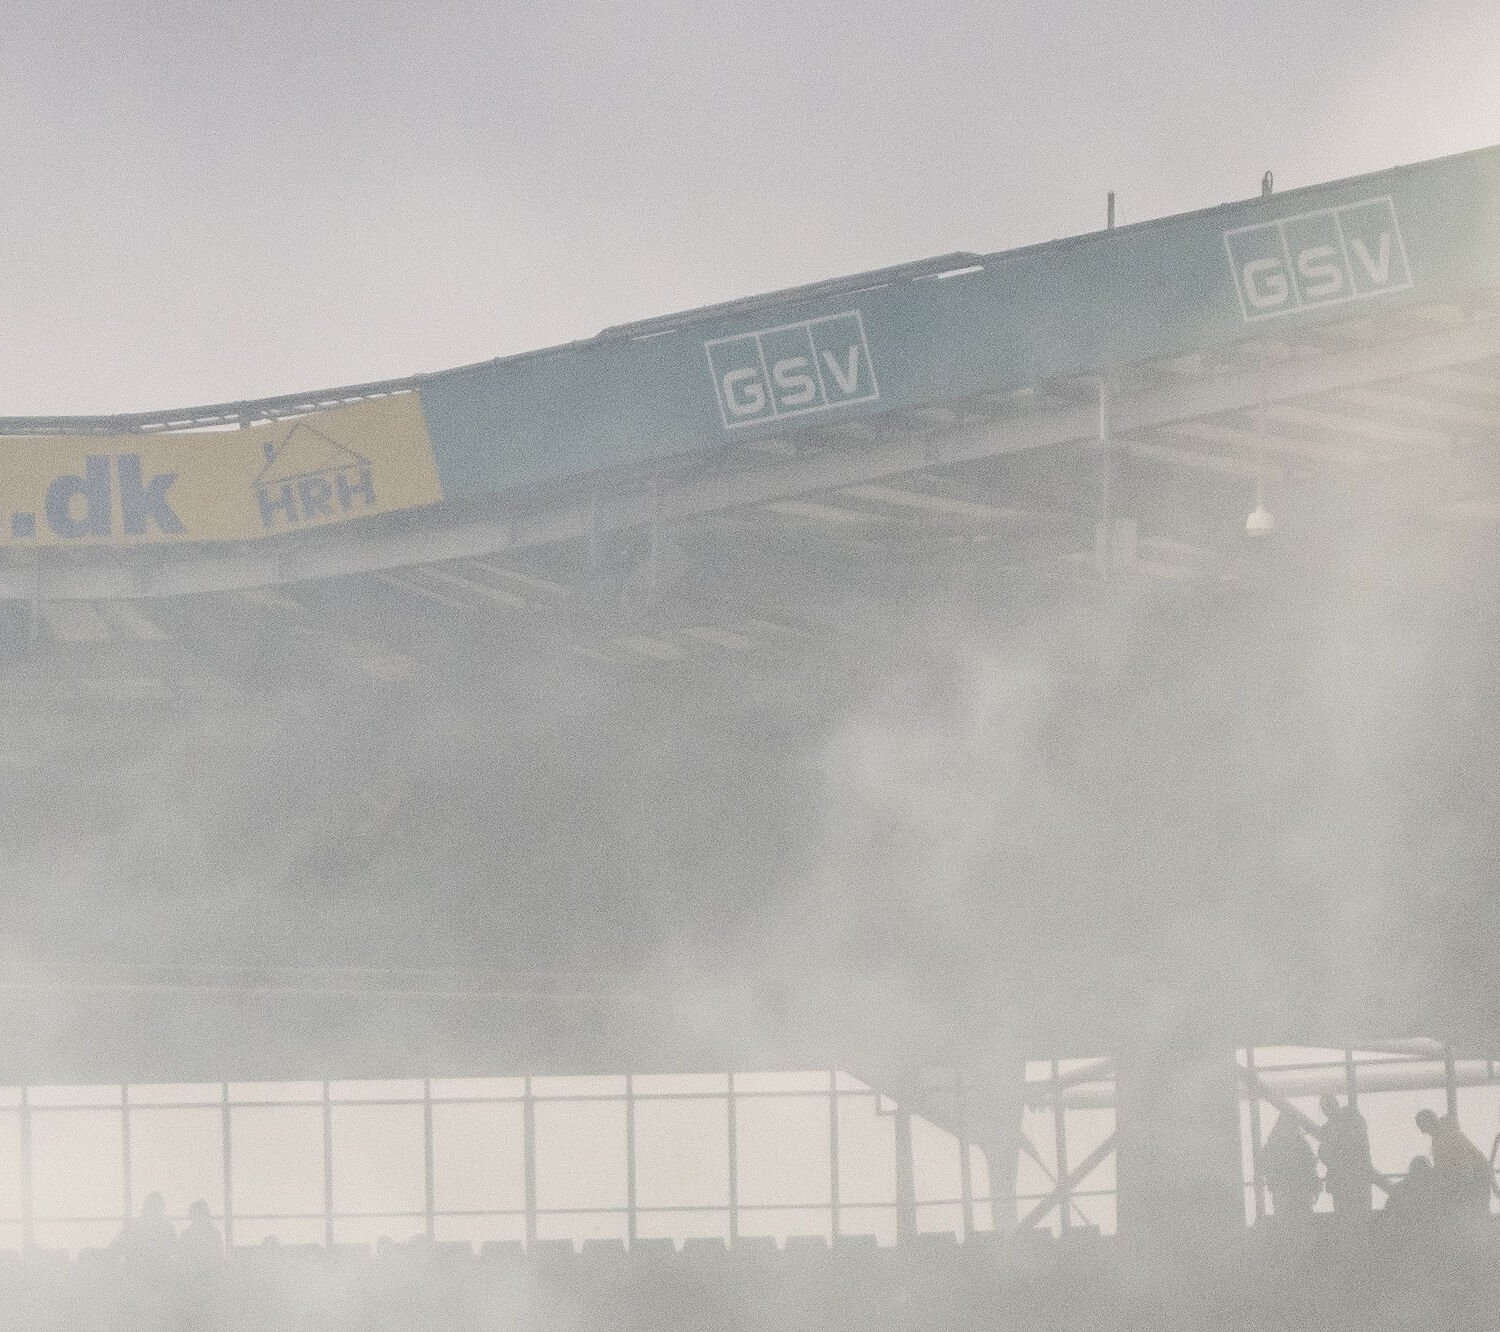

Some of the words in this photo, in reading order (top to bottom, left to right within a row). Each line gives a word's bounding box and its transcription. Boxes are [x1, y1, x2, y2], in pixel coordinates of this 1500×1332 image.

[1243, 232, 1393, 311] GSV
[721, 344, 860, 416] GSV
[256, 462, 377, 529] HRH
